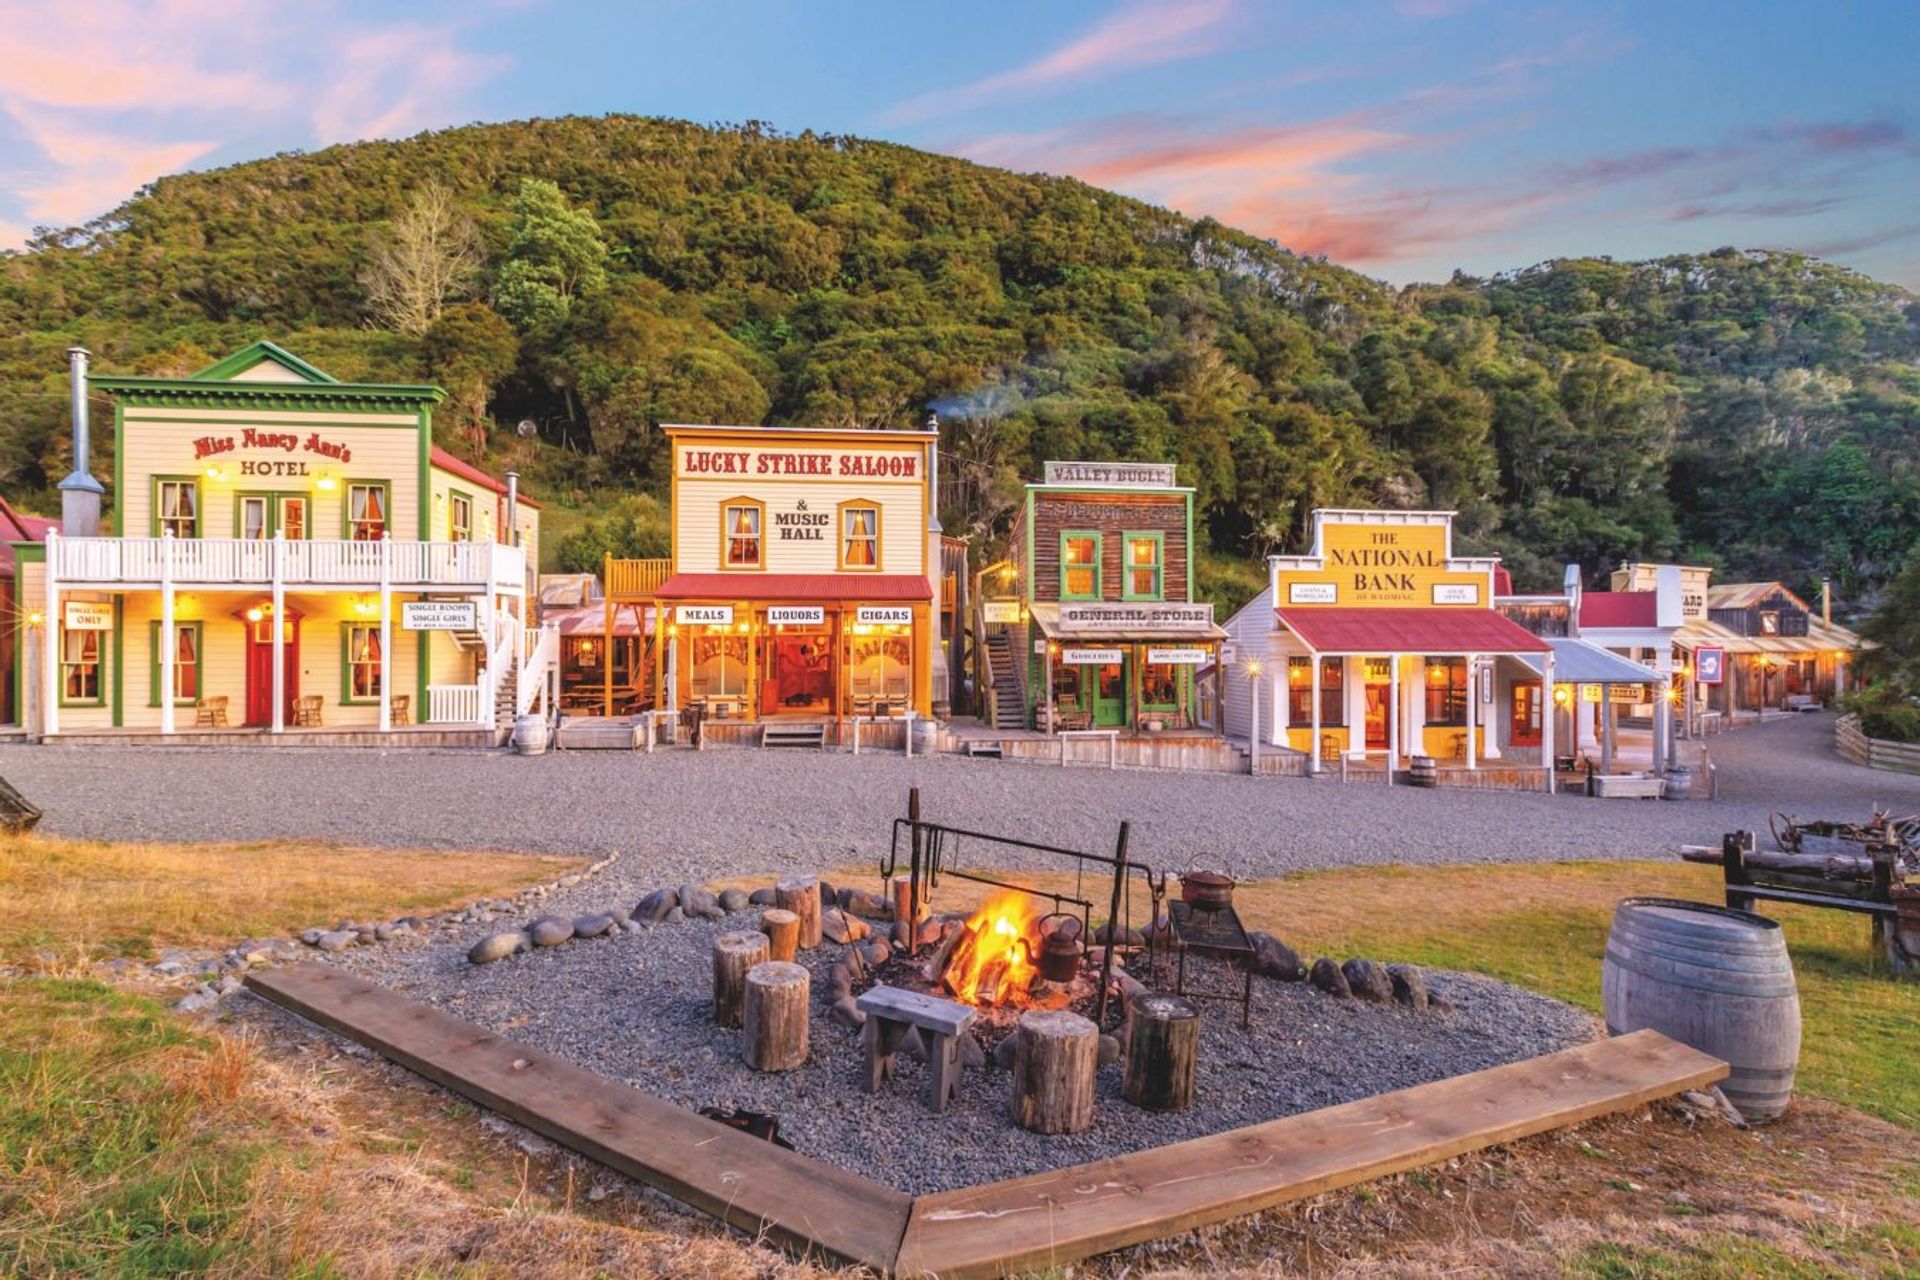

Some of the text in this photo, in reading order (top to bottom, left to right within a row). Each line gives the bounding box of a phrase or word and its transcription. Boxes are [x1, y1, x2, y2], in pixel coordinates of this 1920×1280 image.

[193, 427, 352, 463] Miss Nancy Ann's
[241, 461, 310, 477] HOTEL
[685, 451, 917, 477] LUCKY STRIKE SALOON
[1054, 468, 1111, 482] VALLEY
[796, 500, 808, 511] &
[775, 513, 829, 526] MUSIC
[780, 528, 824, 540] HALL
[1371, 533, 1398, 544] THE
[1332, 549, 1439, 567] NATIONAL
[1354, 573, 1416, 591] BANK
[77, 615, 102, 624] ONLY
[412, 614, 467, 622] SINGLE GIRLS
[685, 610, 724, 620] MEALS
[772, 611, 820, 620] LIQUORS
[861, 611, 909, 620] CIGARS
[1068, 611, 1204, 620] GENERAL STORE
